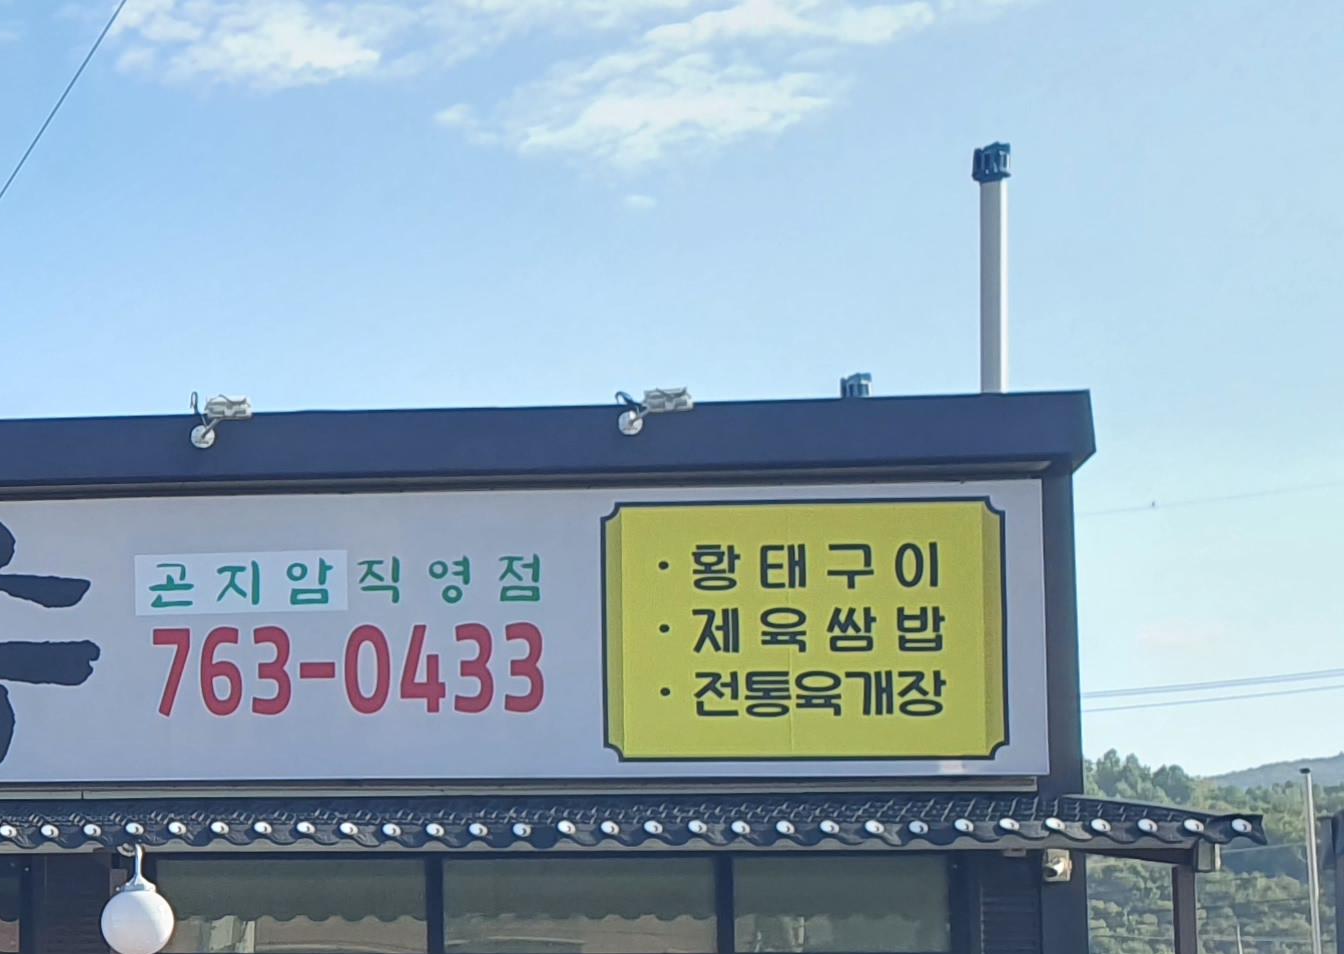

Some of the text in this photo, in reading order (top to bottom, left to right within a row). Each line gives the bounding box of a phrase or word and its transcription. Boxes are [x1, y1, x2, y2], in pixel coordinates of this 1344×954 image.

[147, 554, 542, 607] 곤지암 직영점
[690, 541, 942, 590] 황태구이
[690, 606, 946, 655] 제육쌈밥
[151, 622, 545, 718] 763-0433
[691, 669, 947, 718] 전통육개장
